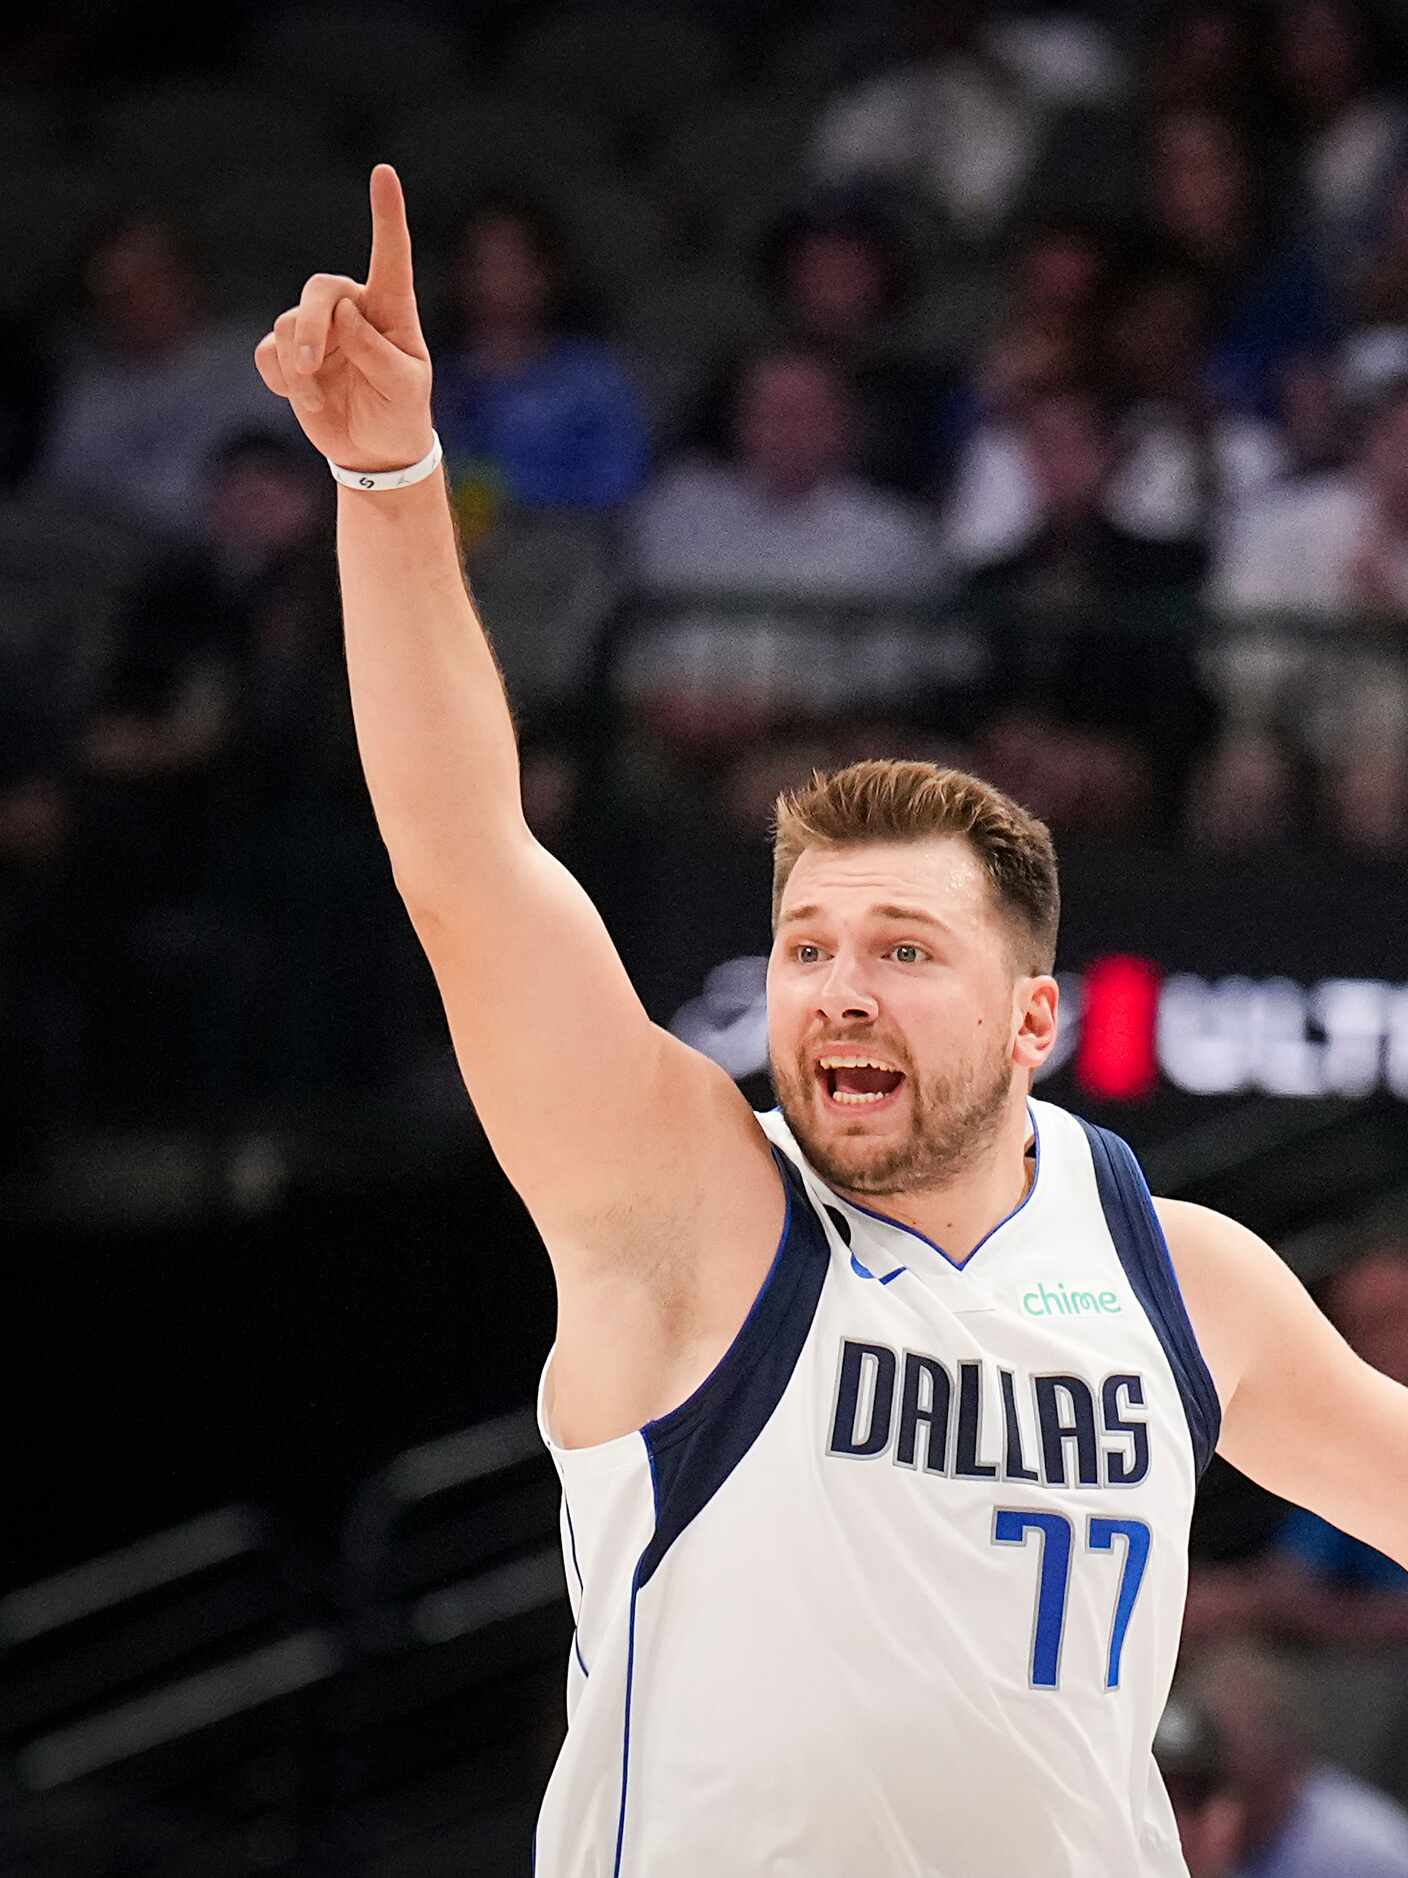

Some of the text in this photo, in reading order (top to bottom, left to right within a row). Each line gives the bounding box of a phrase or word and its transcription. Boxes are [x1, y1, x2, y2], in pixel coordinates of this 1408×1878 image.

[1022, 1283, 1122, 1316] chime
[825, 1335, 1152, 1489] DALLAS
[990, 1504, 1153, 1693] 77
